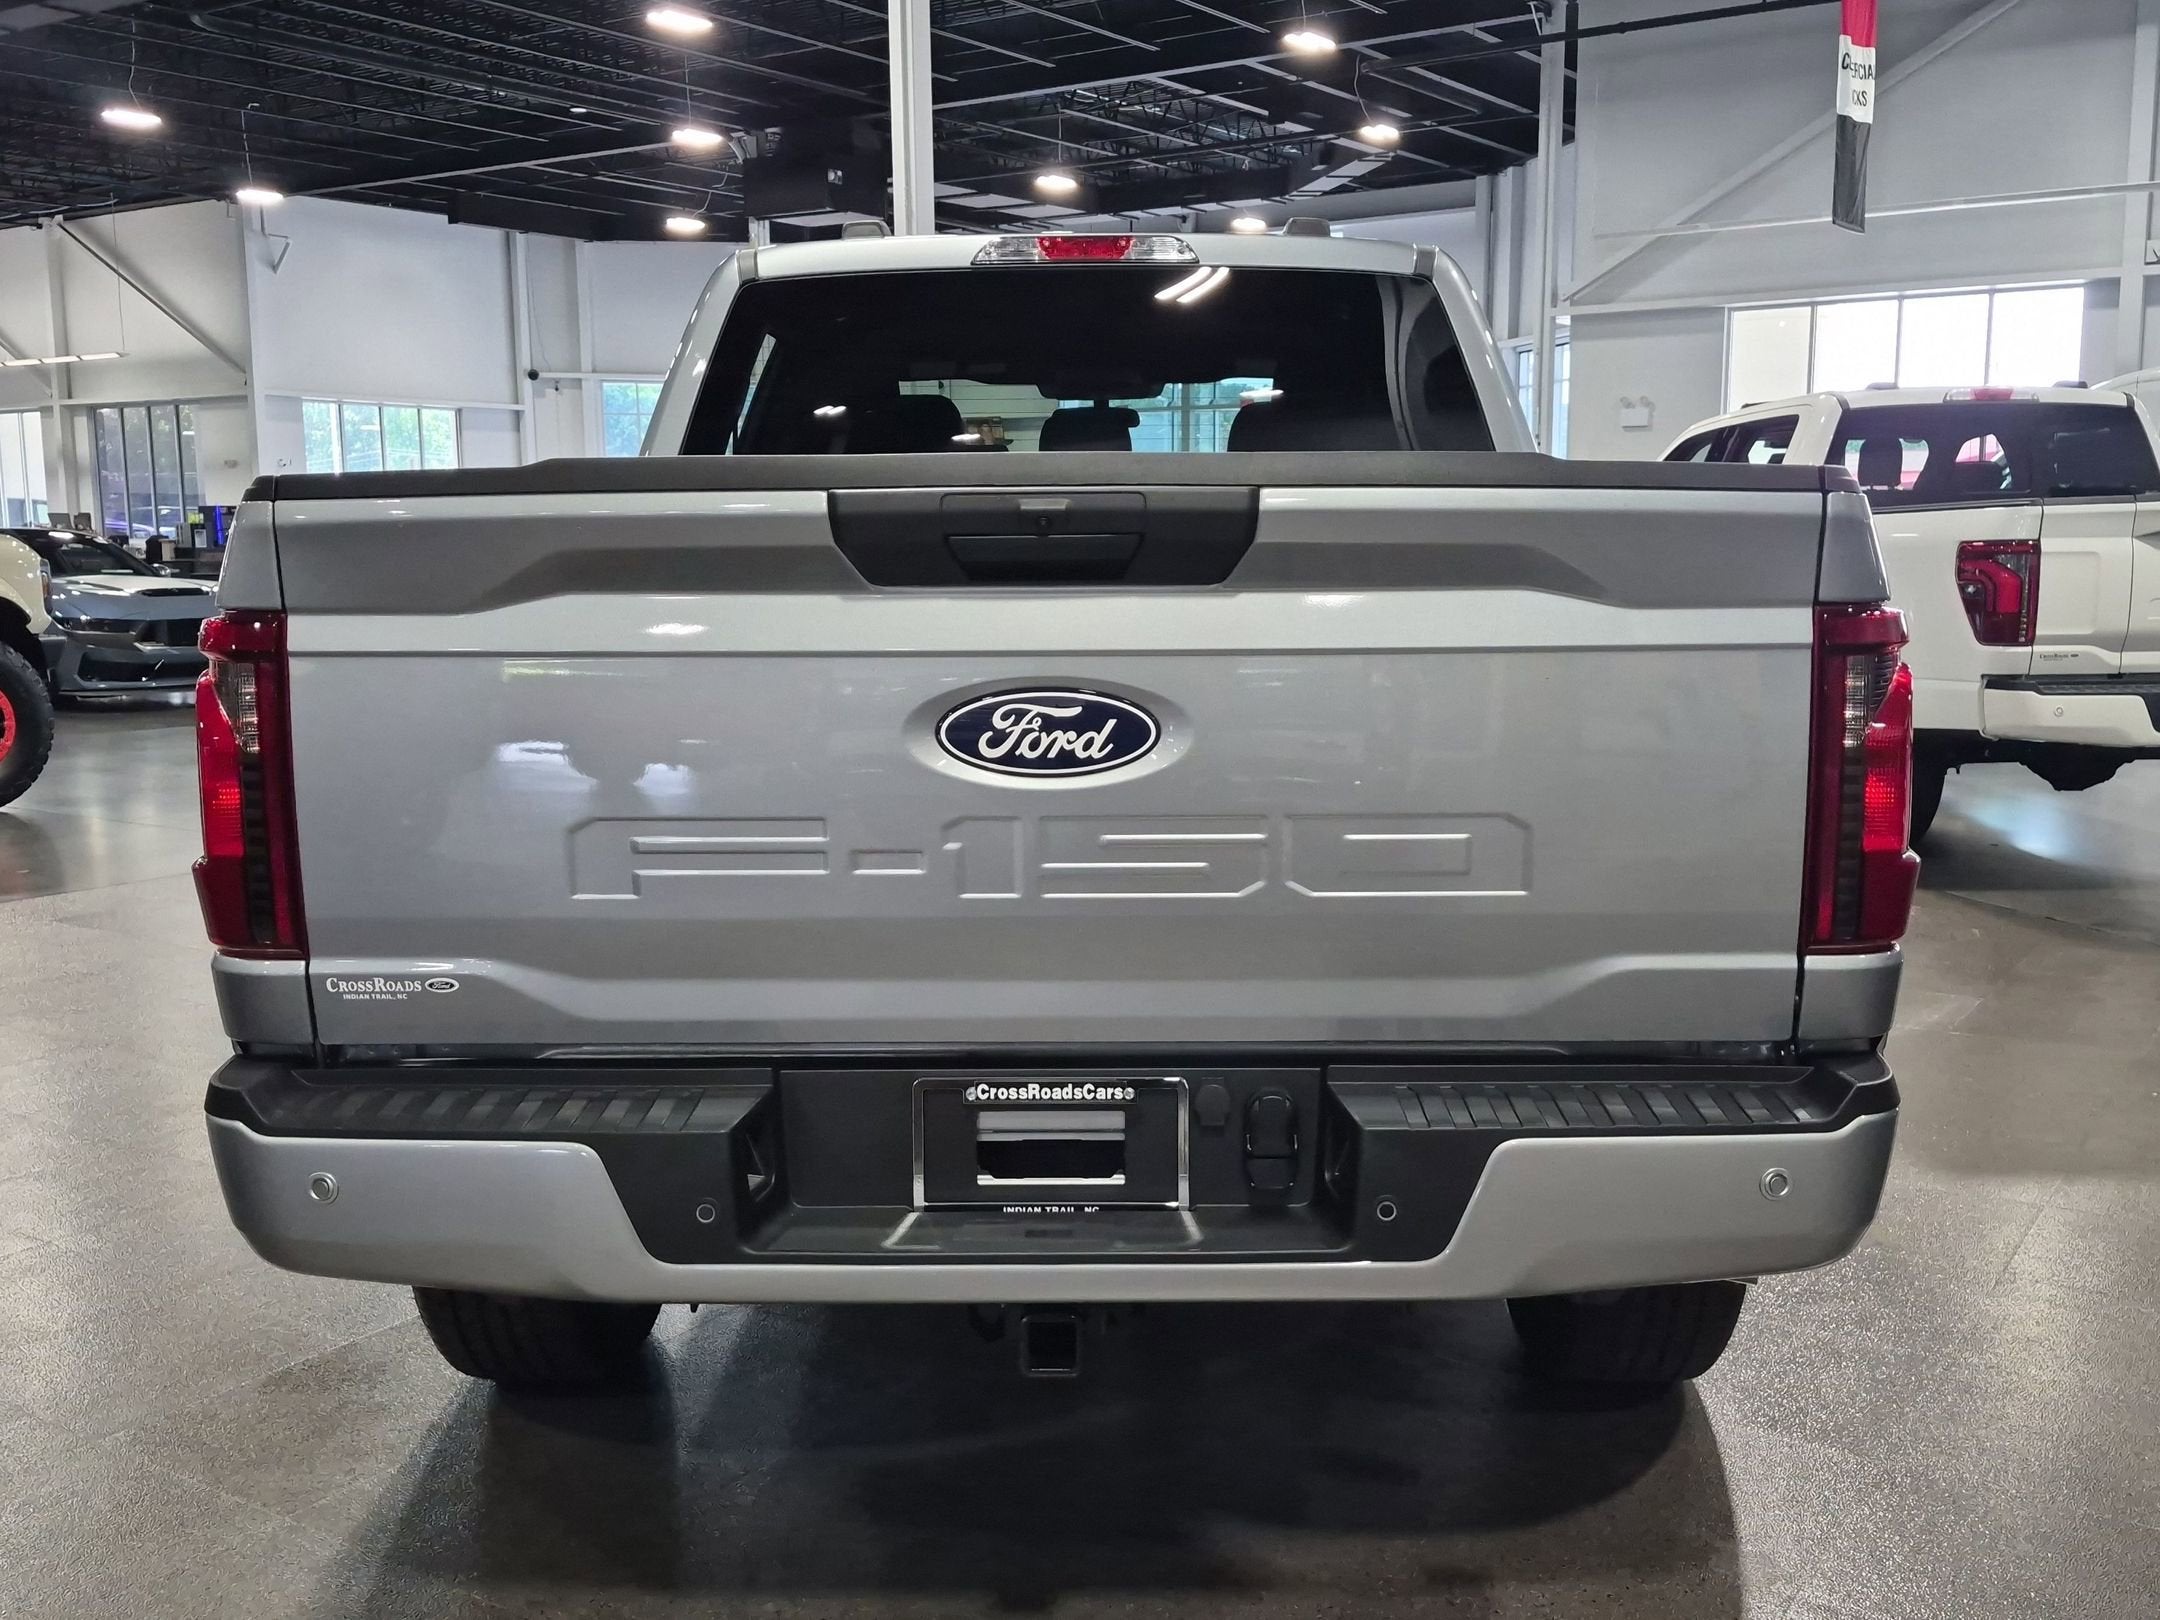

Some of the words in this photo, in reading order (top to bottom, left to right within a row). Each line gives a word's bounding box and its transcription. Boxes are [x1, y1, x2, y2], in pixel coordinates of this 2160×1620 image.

[978, 703, 1117, 759] Ford
[565, 813, 1533, 900] F-150
[976, 1083, 1124, 1100] CrossRoadsCars
